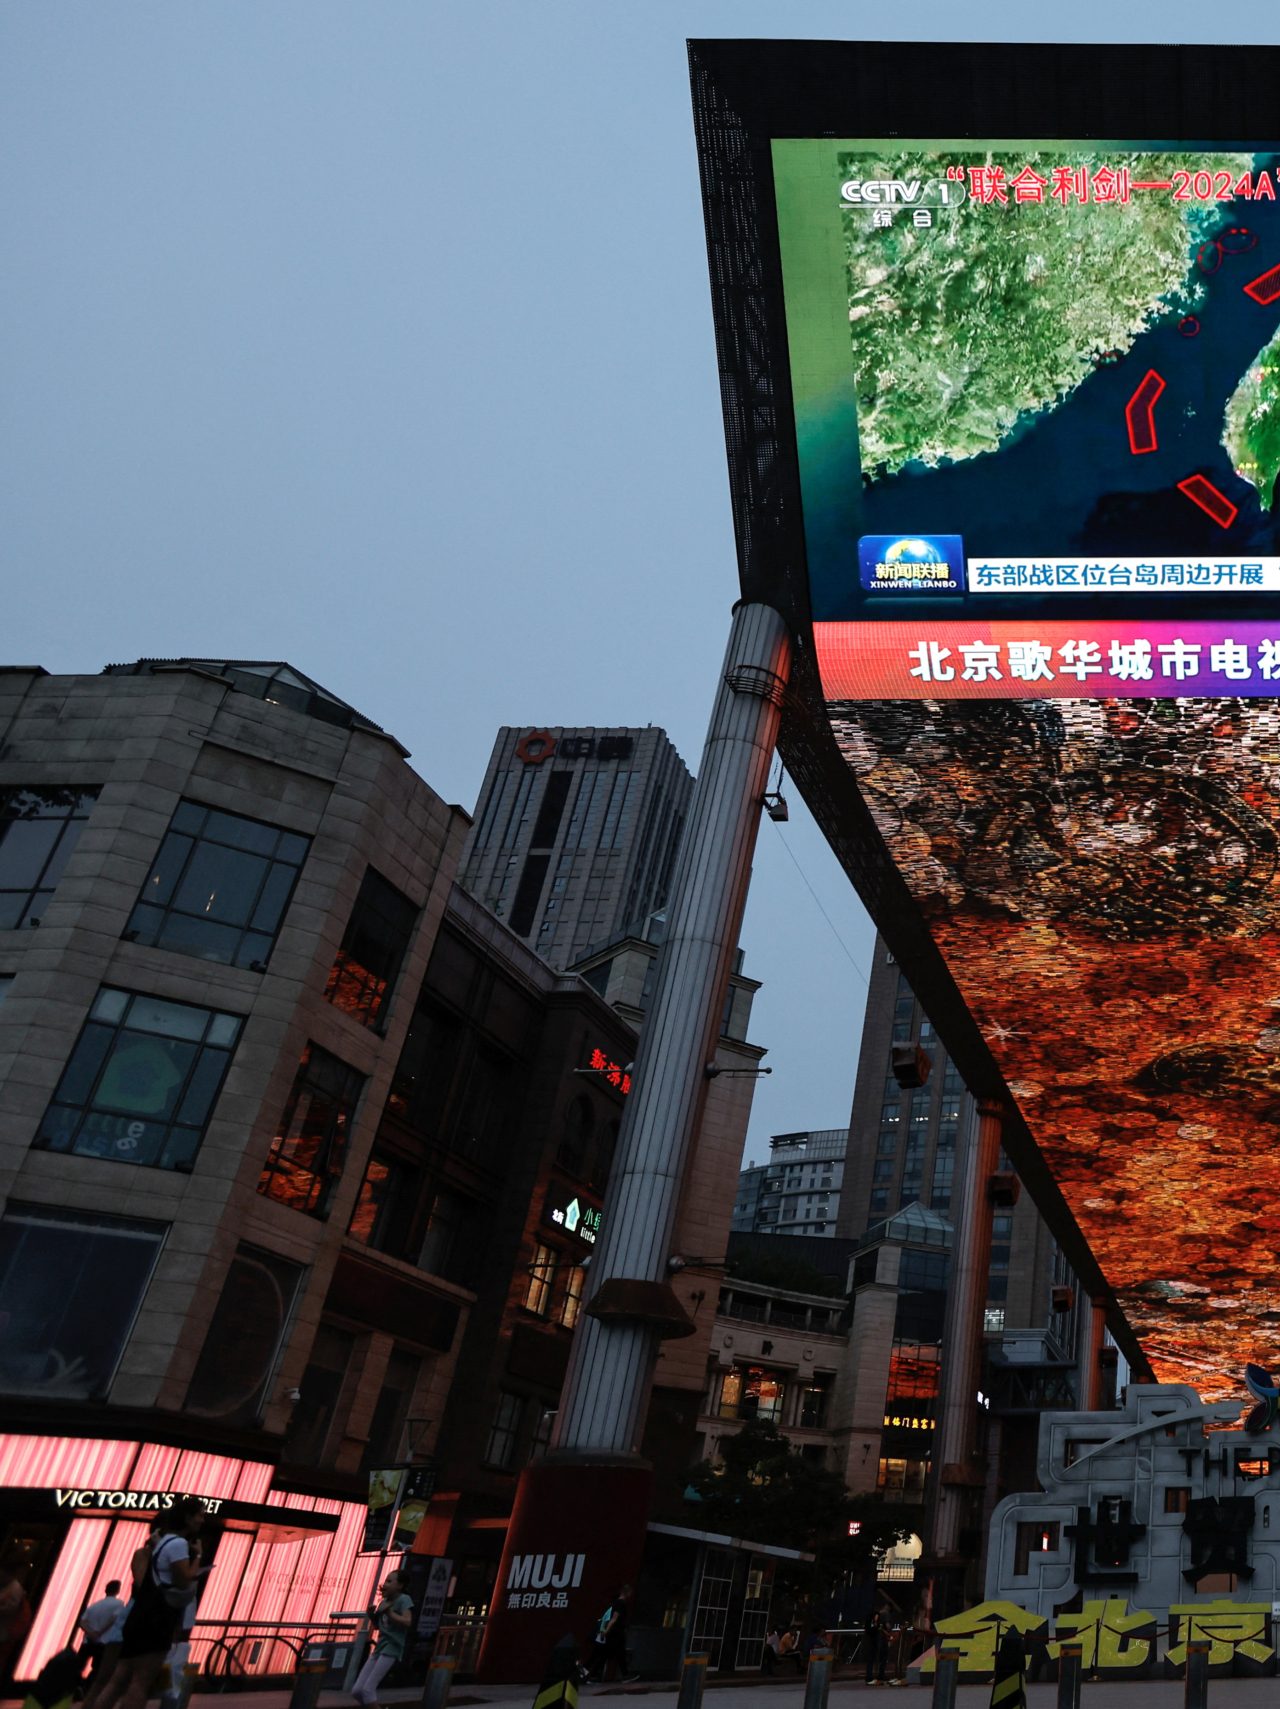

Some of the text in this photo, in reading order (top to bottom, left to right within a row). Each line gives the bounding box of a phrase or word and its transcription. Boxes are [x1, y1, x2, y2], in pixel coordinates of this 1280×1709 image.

[840, 180, 950, 205] CCTV 1
[872, 209, 932, 229] 综合
[875, 561, 950, 580] 新闻联播
[870, 580, 957, 589] XINWEN LIANBO
[1178, 1447, 1252, 1478] THE
[55, 1488, 223, 1515] VICTORIA'S RET
[506, 1553, 586, 1589] MUJI
[507, 1591, 569, 1609] 無印良品
